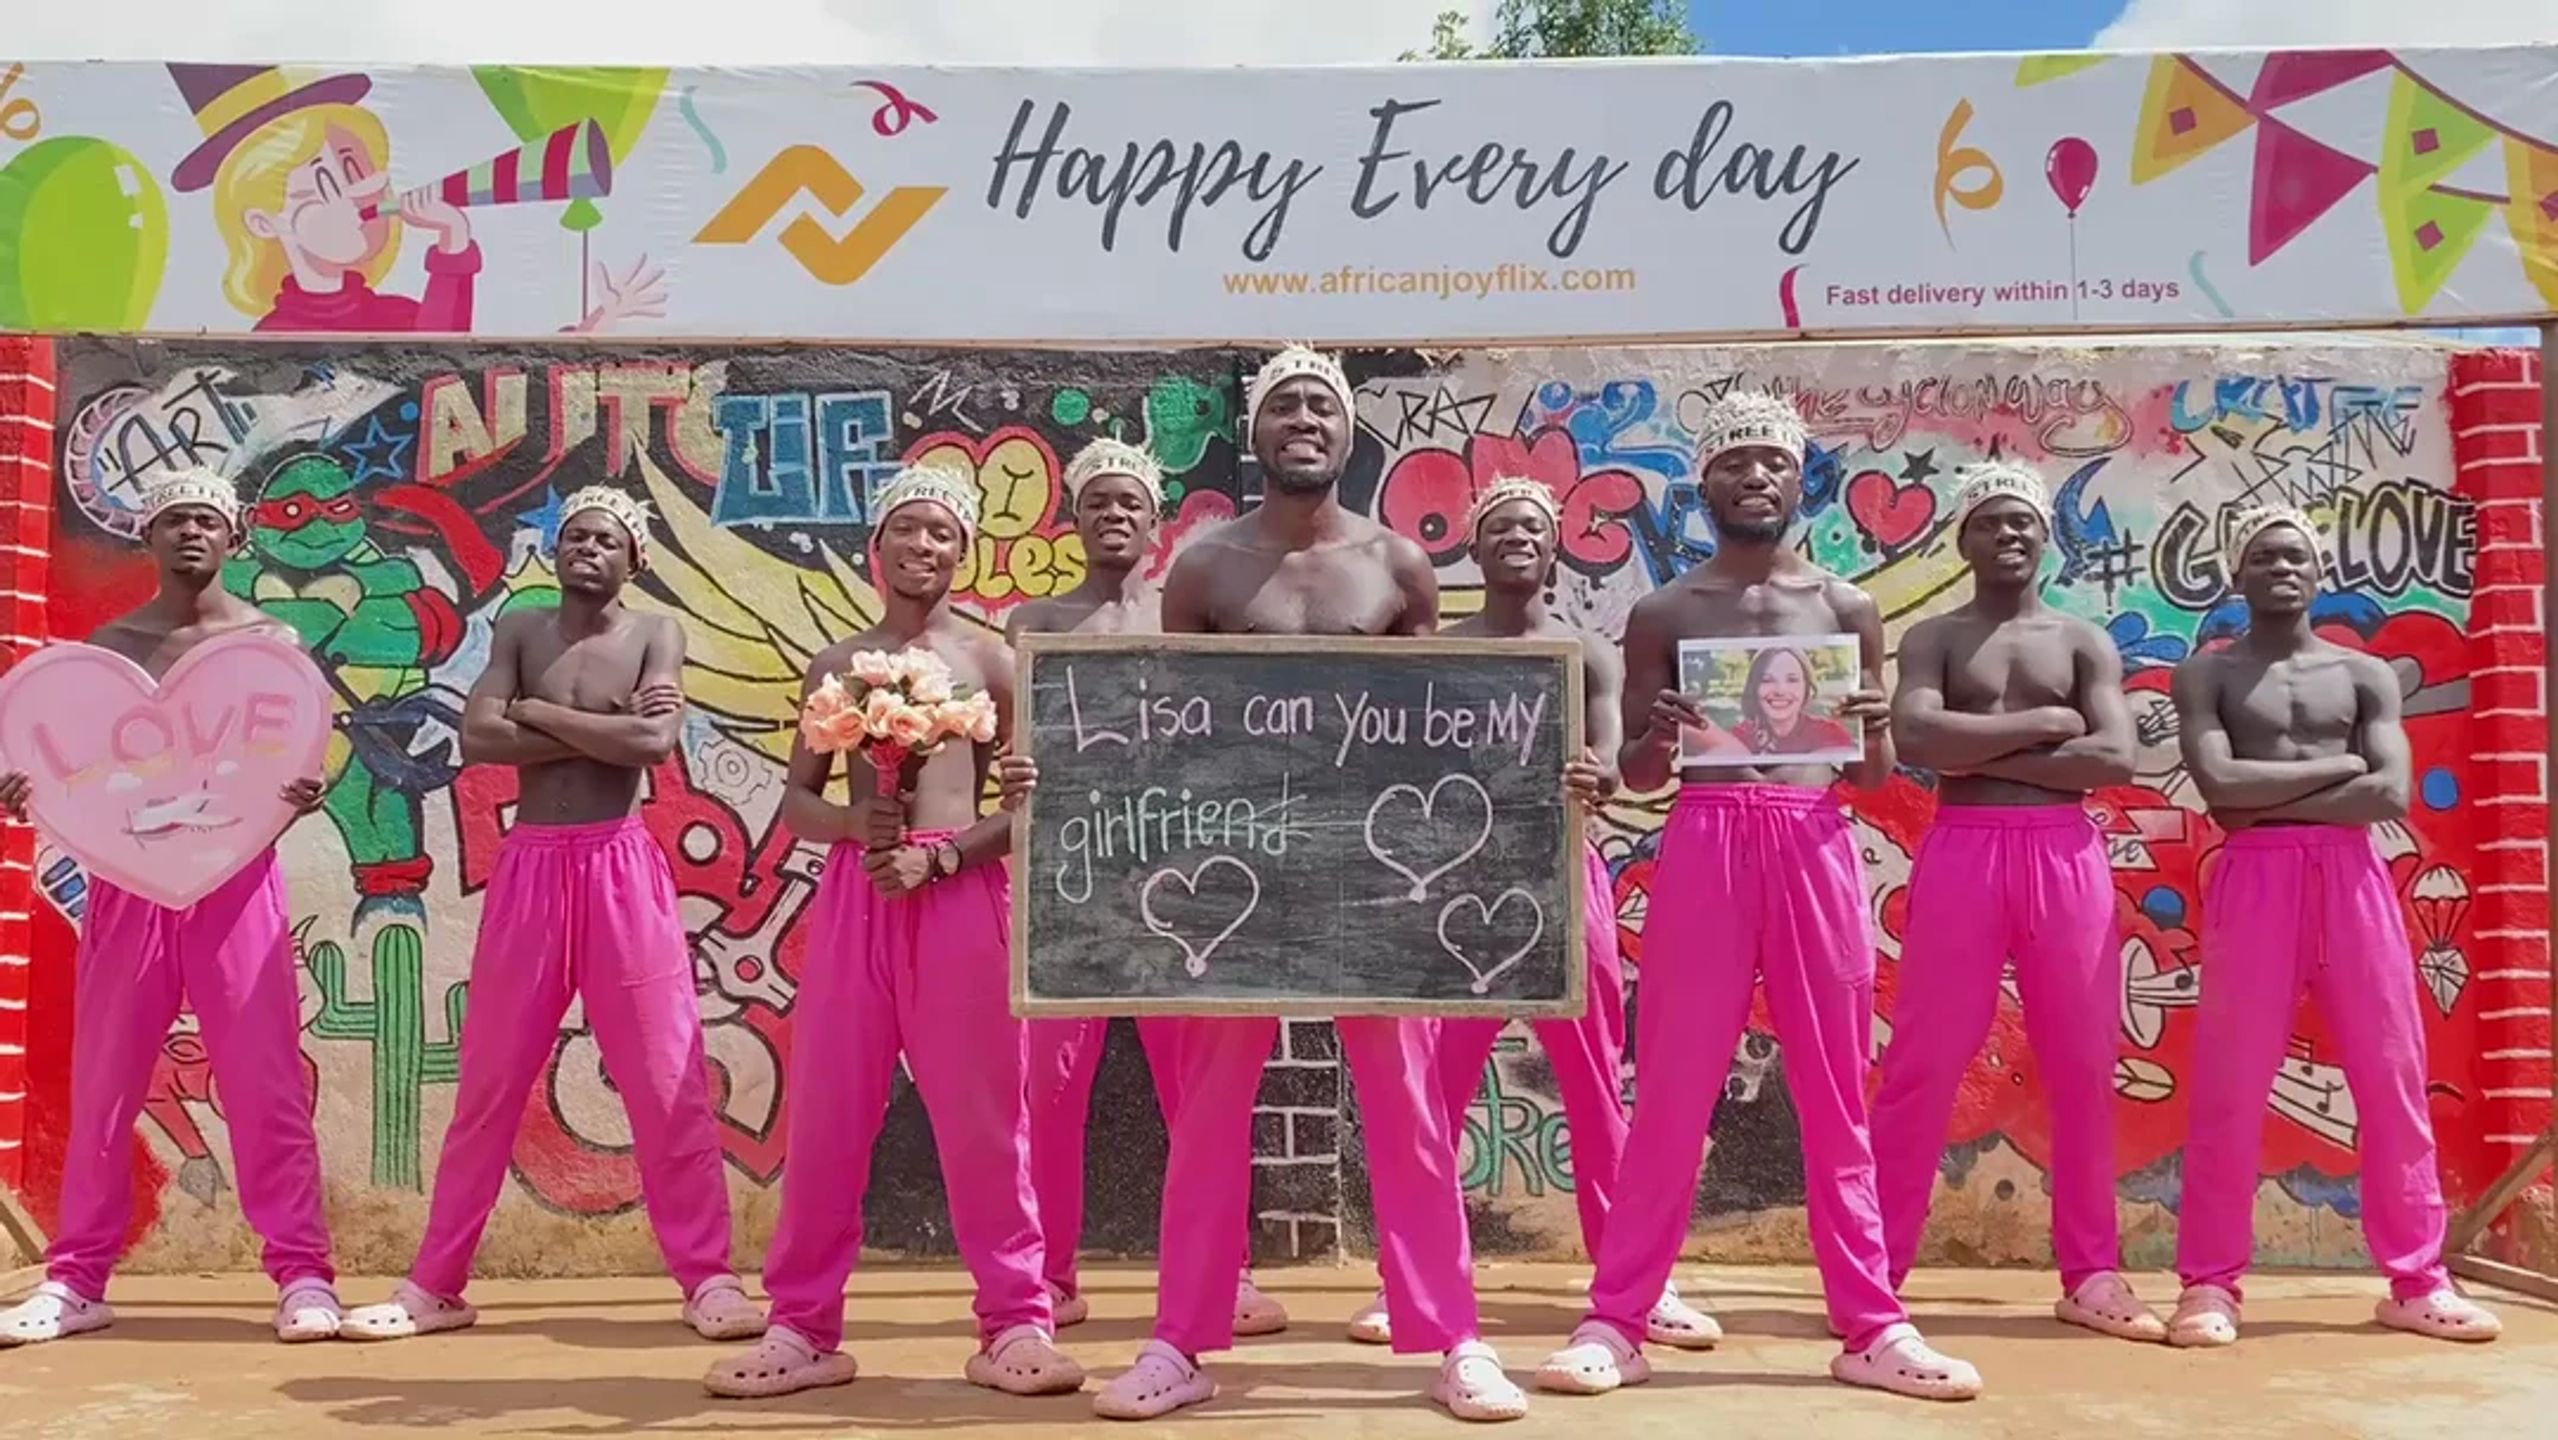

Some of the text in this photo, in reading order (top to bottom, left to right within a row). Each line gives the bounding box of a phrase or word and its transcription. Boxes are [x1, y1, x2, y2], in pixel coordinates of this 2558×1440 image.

[987, 98, 1861, 262] Happy Every day
[1223, 263, 1636, 300] www.africanjoyflix.com
[1826, 278, 2180, 308] Fast delivery within 1-3 days
[31, 692, 296, 784] LOVE
[1065, 664, 1212, 753] Lisa
[1242, 692, 1315, 737] can
[1423, 680, 1474, 749] be
[1055, 770, 1292, 904] girlfriend
